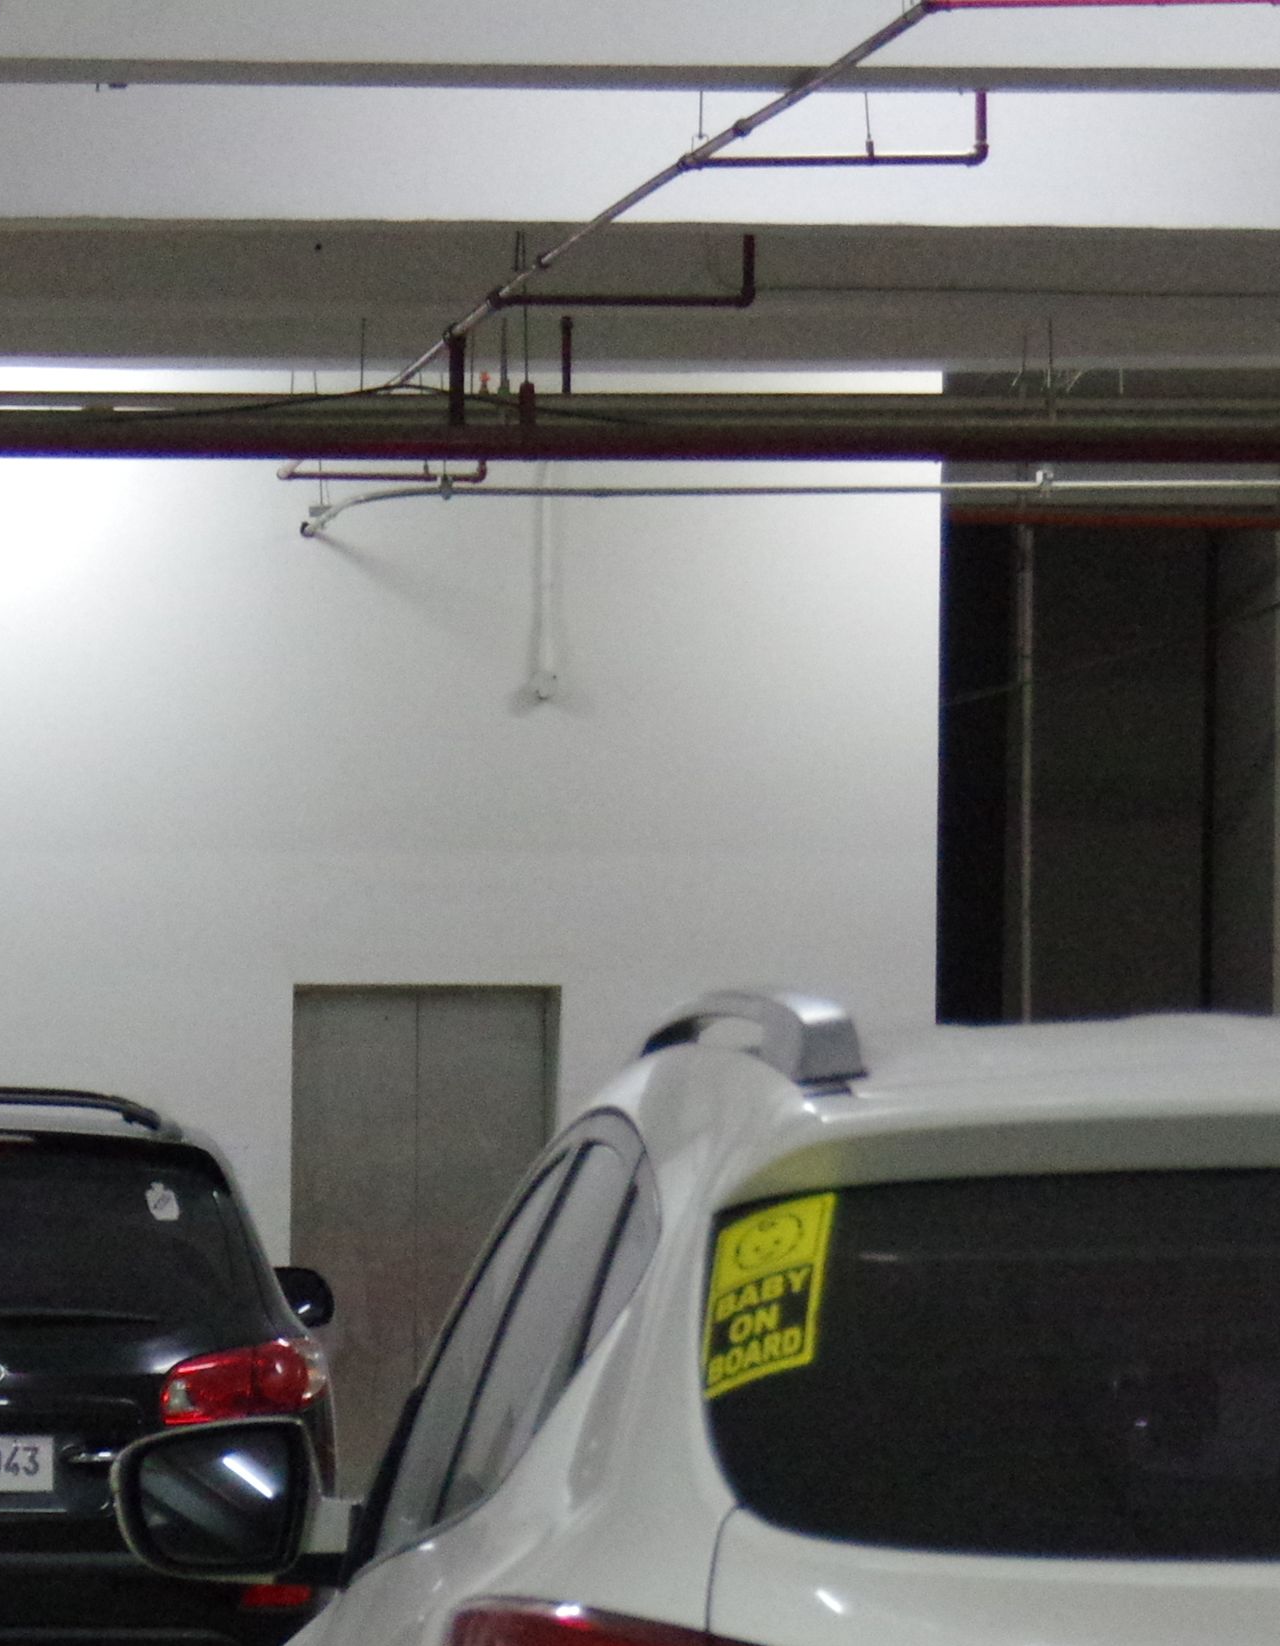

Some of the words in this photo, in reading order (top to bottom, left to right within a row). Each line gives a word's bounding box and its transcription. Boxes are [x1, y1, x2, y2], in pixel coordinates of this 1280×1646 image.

[715, 1266, 812, 1321] BABY
[728, 1303, 781, 1344] ON
[707, 1325, 804, 1382] BOARD
